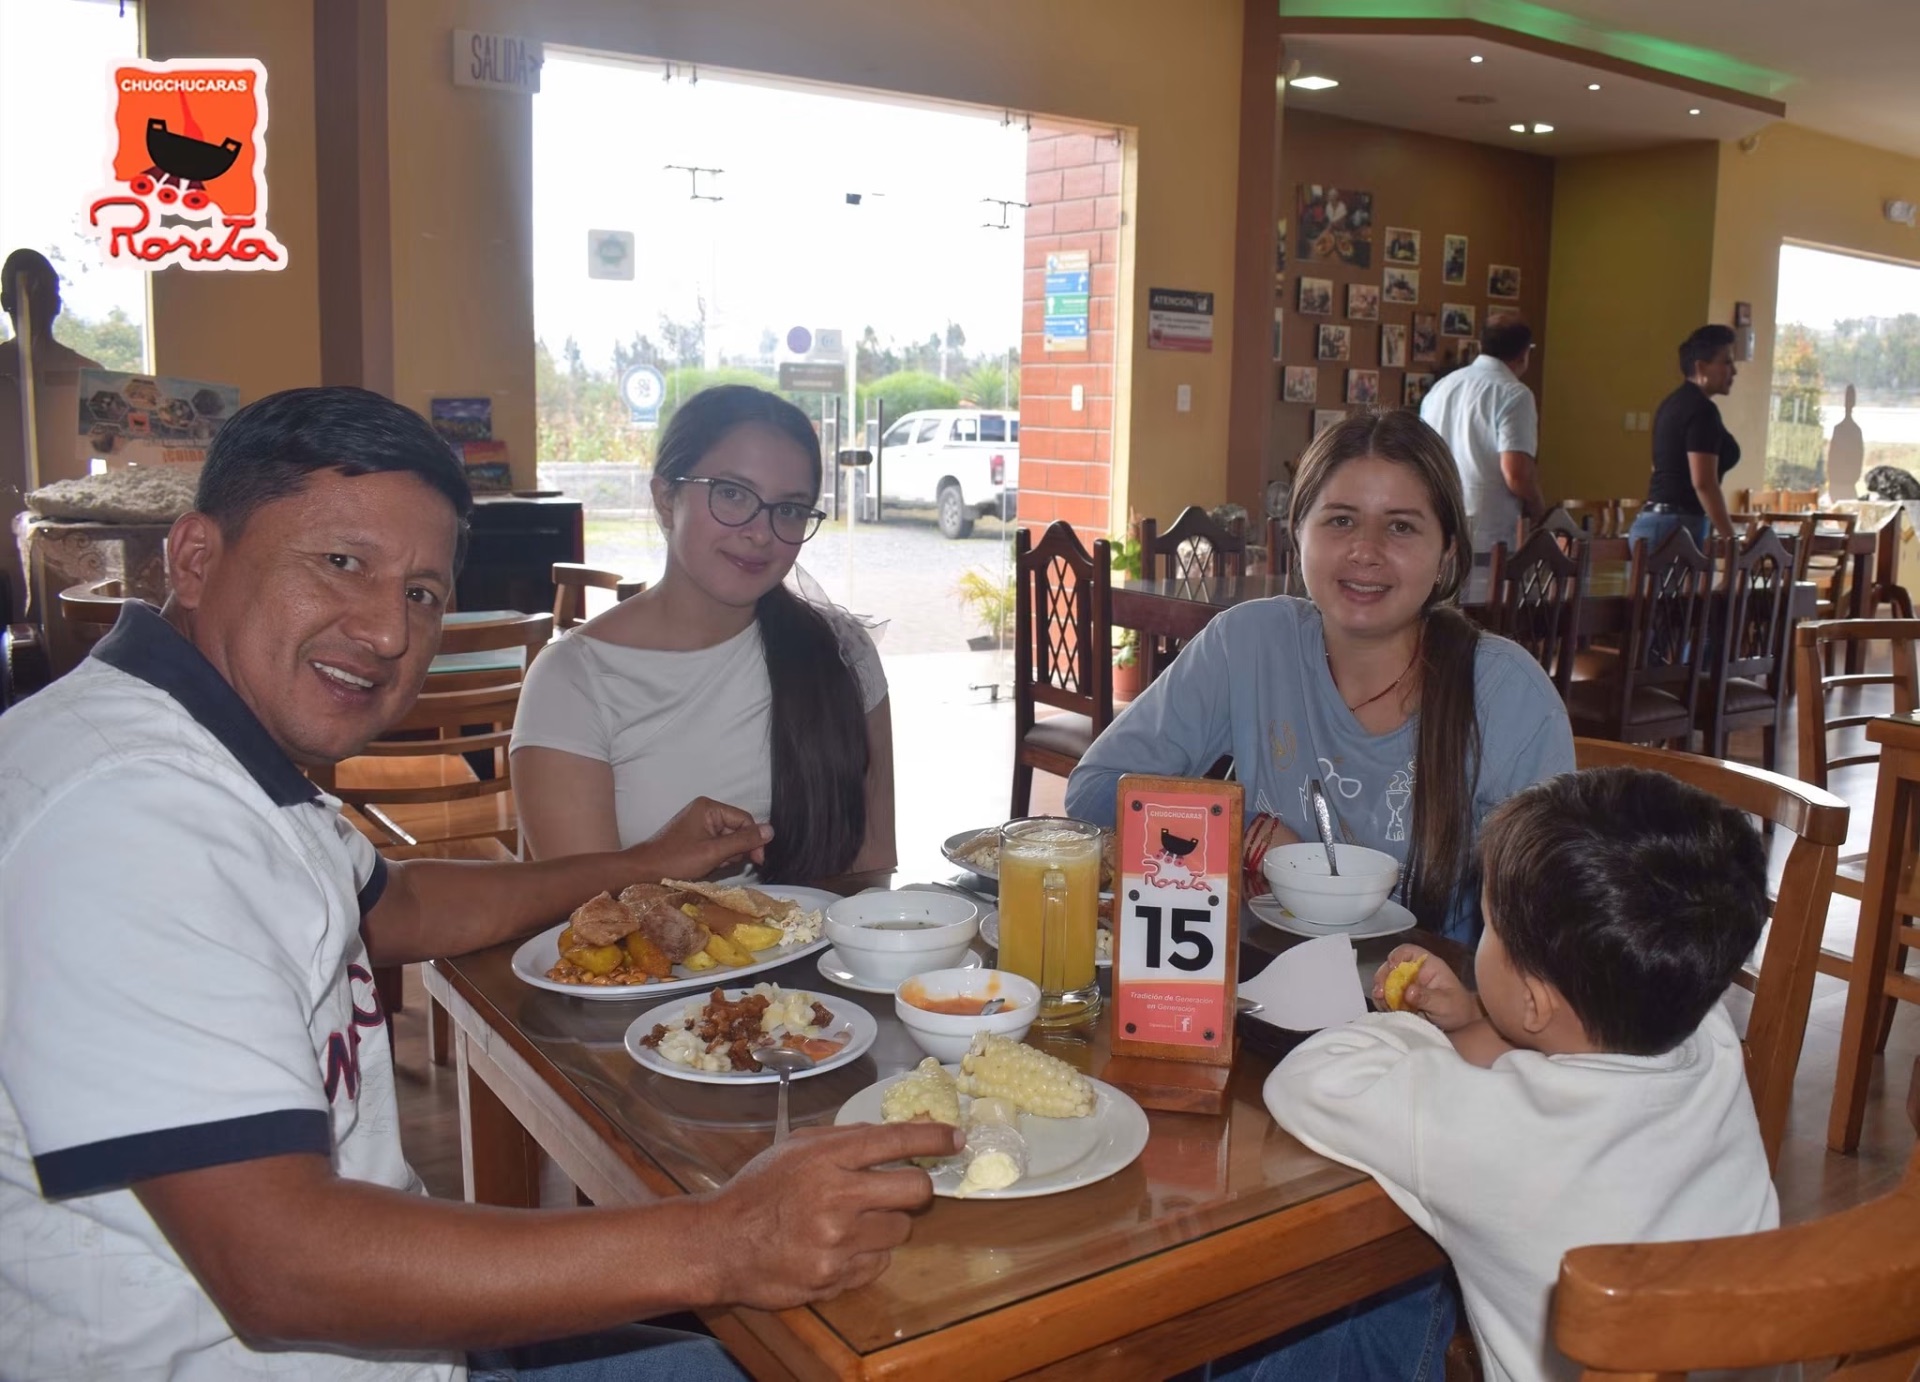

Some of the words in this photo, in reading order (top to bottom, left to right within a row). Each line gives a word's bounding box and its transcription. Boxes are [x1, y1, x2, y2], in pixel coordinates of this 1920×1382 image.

[471, 34, 528, 85] SALIDA
[1150, 810, 1203, 820] CHUGCHUCARAS
[1135, 905, 1213, 971] 15
[1130, 991, 1163, 1001] Tradición
[1175, 995, 1214, 1004] Generación
[1157, 1003, 1196, 1013] Generación
